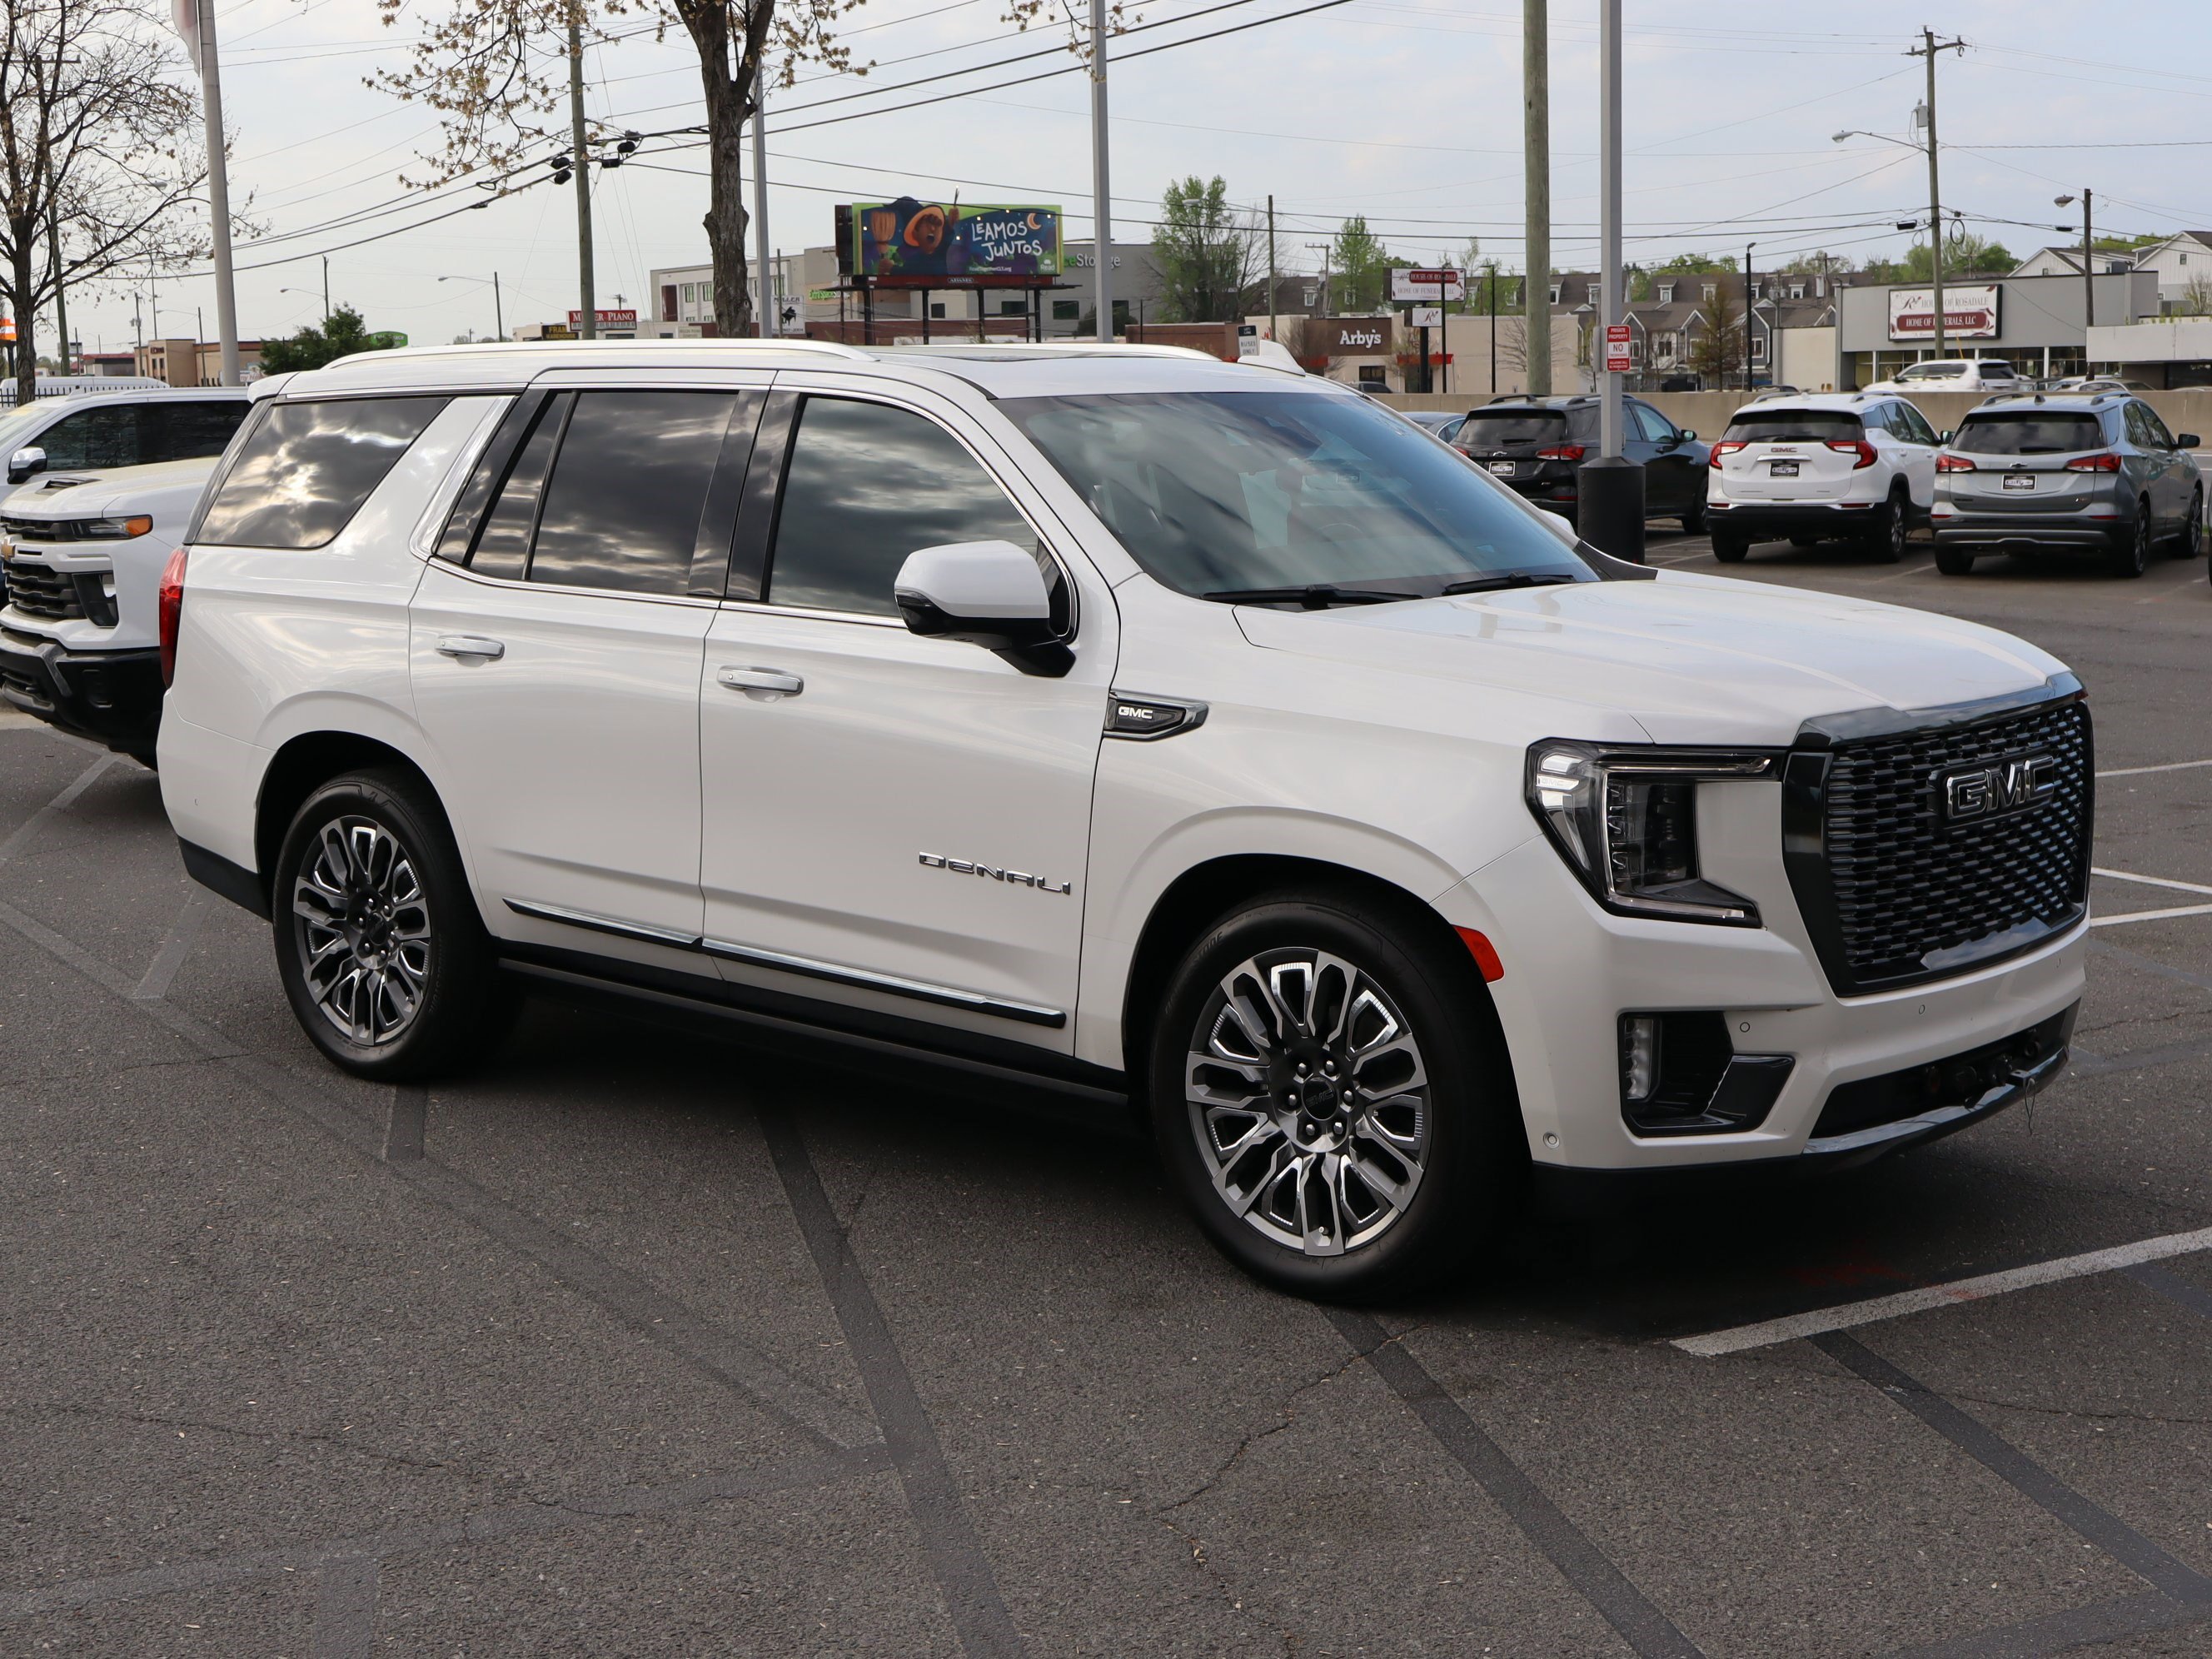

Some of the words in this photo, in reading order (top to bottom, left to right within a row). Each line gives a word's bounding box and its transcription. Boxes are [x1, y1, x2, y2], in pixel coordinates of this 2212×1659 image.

[971, 222, 1028, 242] LEAMOS
[981, 239, 1043, 262] JUNTOS
[607, 311, 635, 321] PIANO
[1906, 317, 1923, 327] HOME
[1924, 317, 1932, 326] OF
[1965, 316, 1977, 325] LLC
[1340, 330, 1382, 349] Arby's
[1612, 343, 1624, 352] NO
[1118, 705, 1154, 720] GMC
[1946, 754, 2055, 820] GMC
[919, 851, 1071, 895] DENALI
